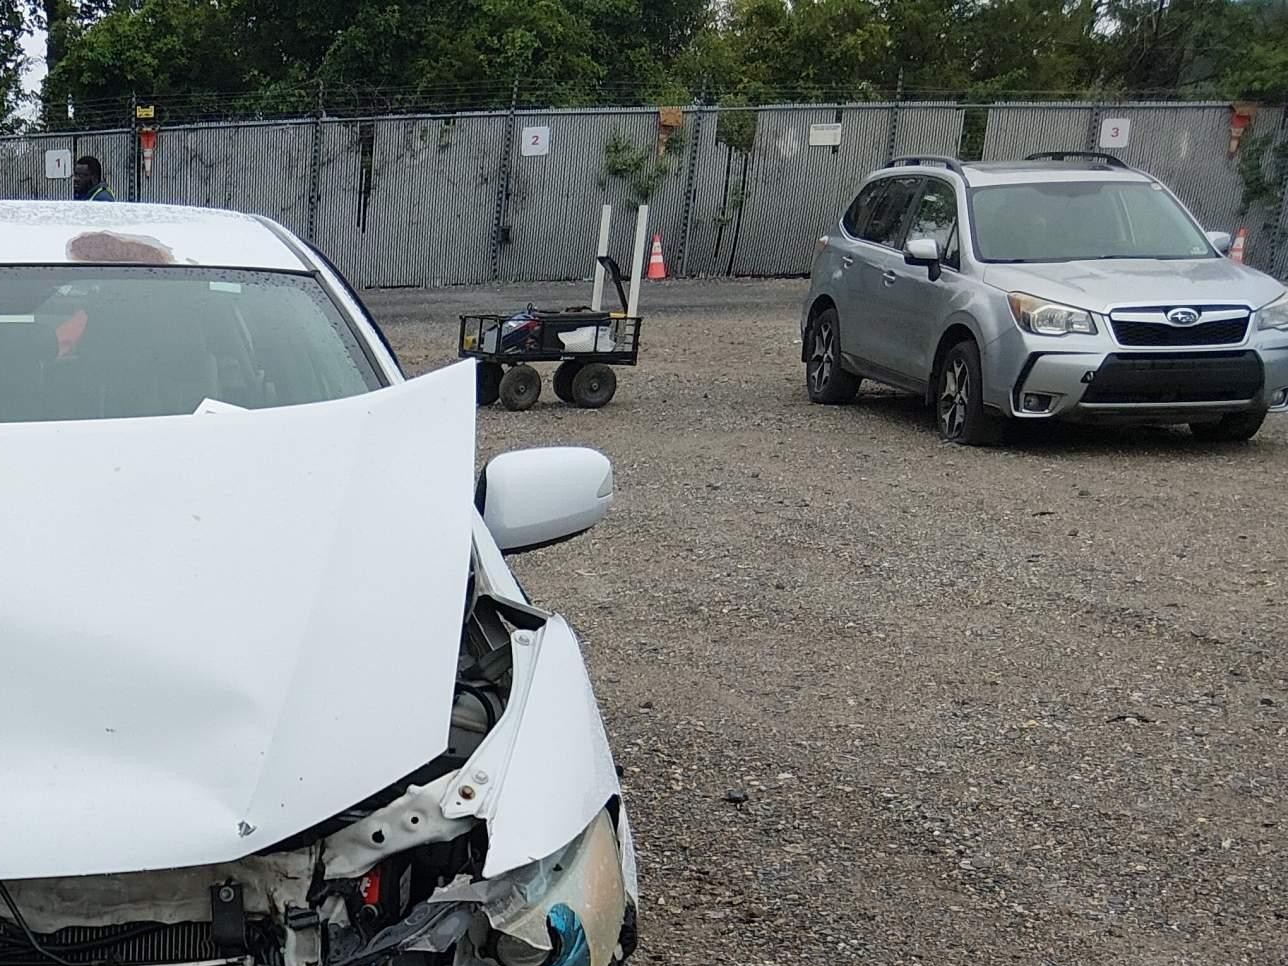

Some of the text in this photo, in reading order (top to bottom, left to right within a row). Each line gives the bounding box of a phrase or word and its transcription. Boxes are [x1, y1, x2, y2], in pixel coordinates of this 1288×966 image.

[1111, 127, 1119, 138] 3
[531, 135, 539, 145] 2
[55, 158, 61, 169] 1
